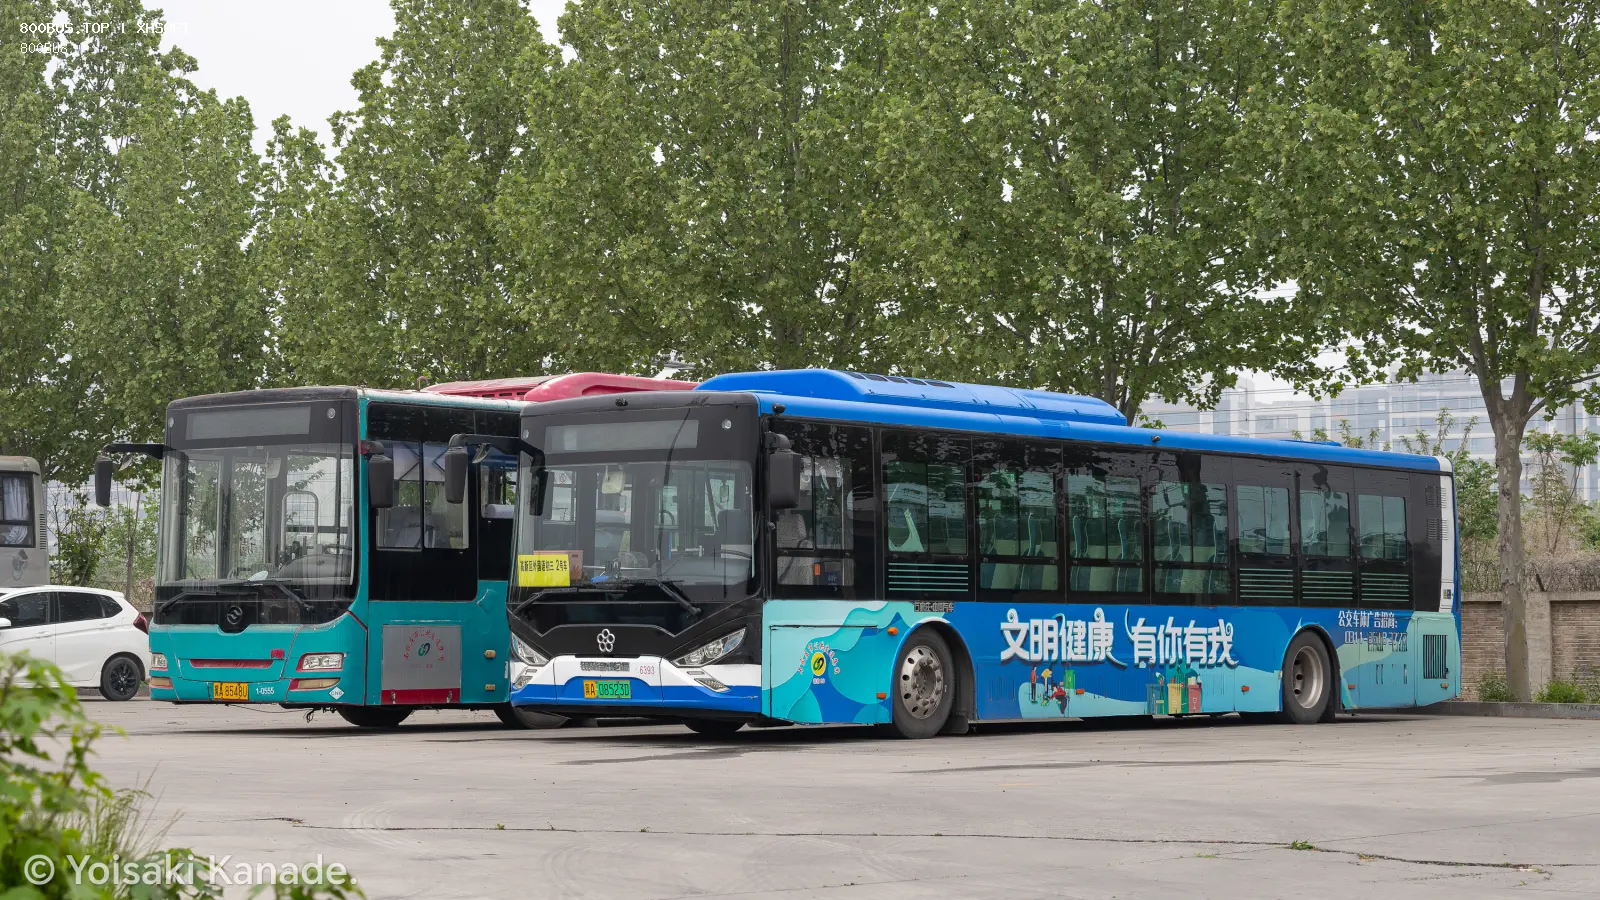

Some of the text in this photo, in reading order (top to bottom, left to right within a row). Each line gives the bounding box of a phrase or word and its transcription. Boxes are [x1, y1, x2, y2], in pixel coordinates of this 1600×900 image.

[1000, 608, 1239, 668] 文明健康 有你有我
[639, 665, 655, 675] 6393
[255, 687, 275, 695] 1-0555
